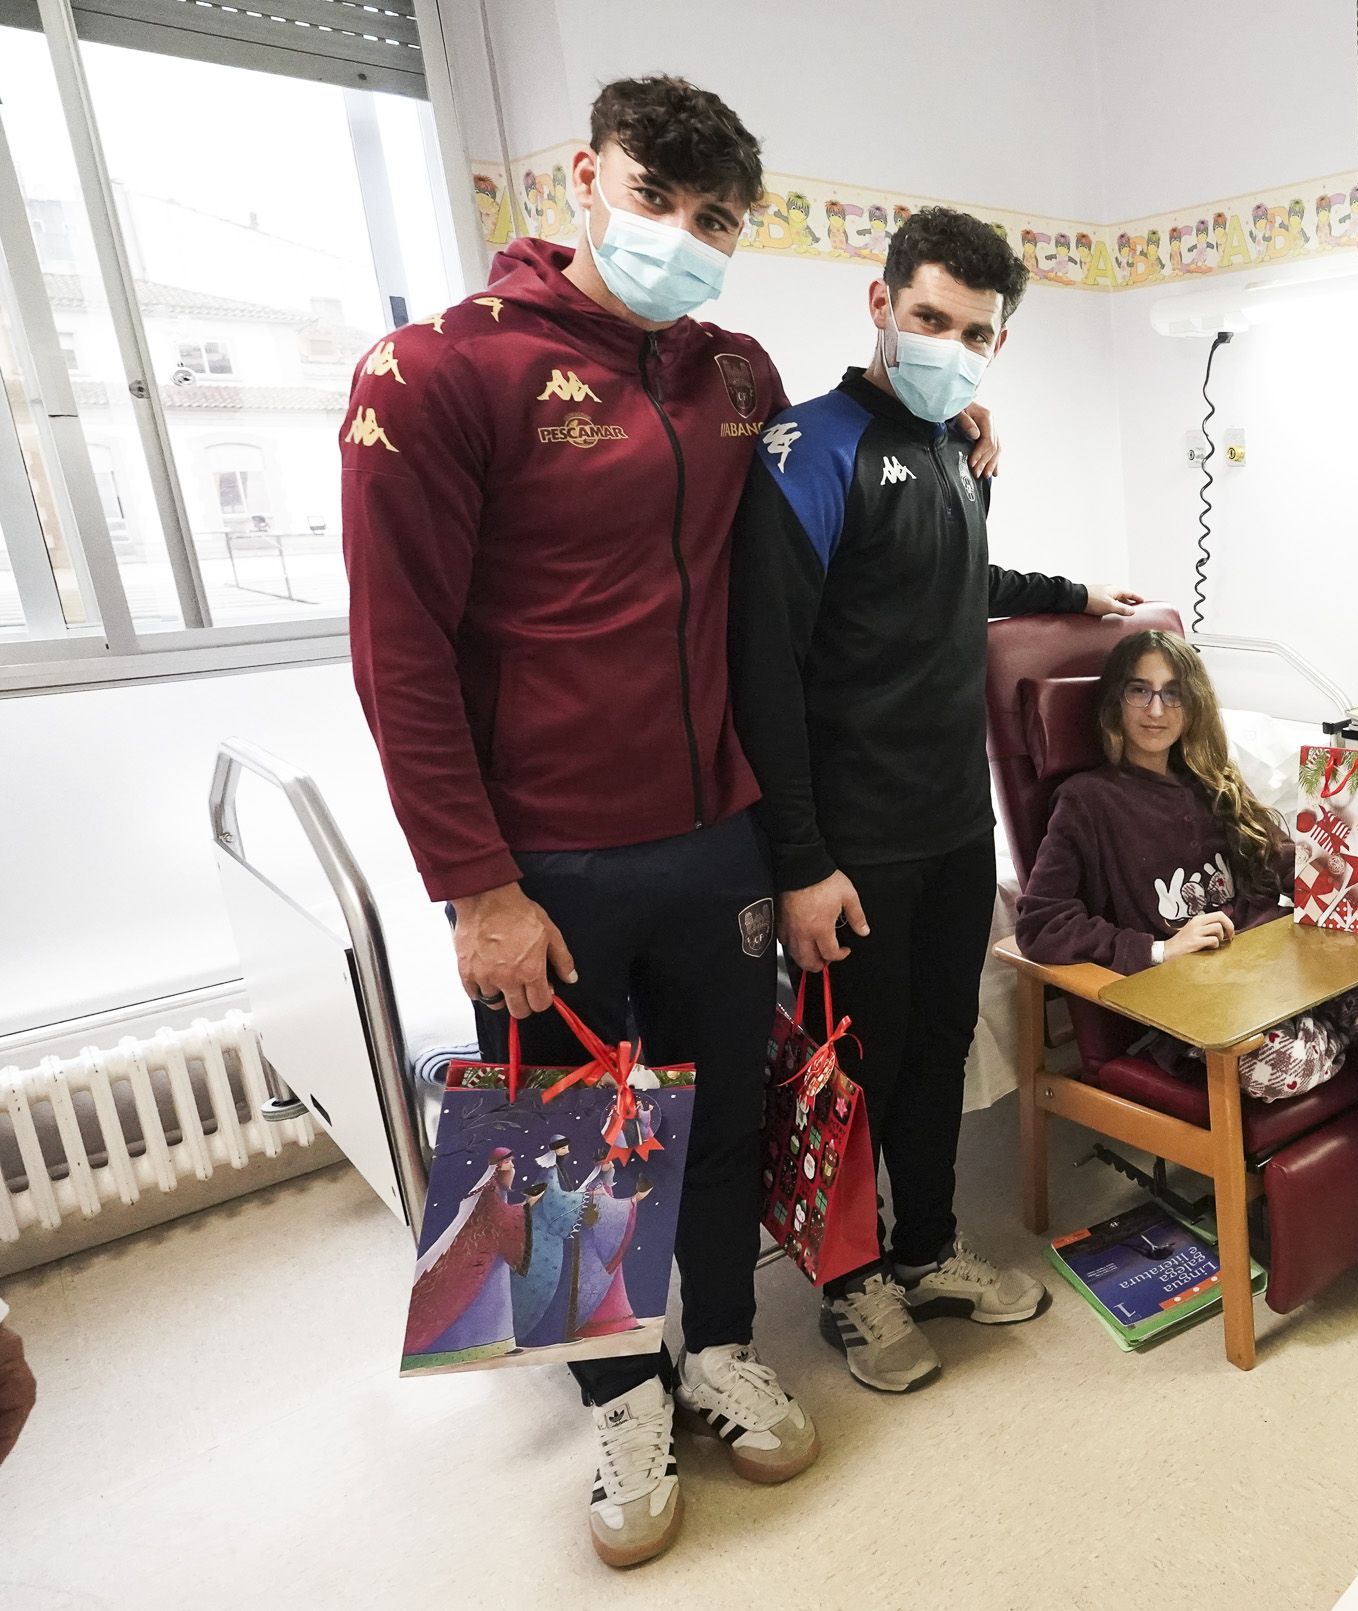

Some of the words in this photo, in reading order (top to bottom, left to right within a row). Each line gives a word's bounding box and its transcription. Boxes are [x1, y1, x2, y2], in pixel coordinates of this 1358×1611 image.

[538, 425, 629, 443] PESCAMAR
[720, 421, 764, 437] ABANC
[1189, 1246, 1198, 1255] e
[1119, 1252, 1189, 1289] literatura
[1160, 1250, 1206, 1282] galega
[1163, 1261, 1218, 1293] Lingua
[1113, 1302, 1136, 1319] 1
